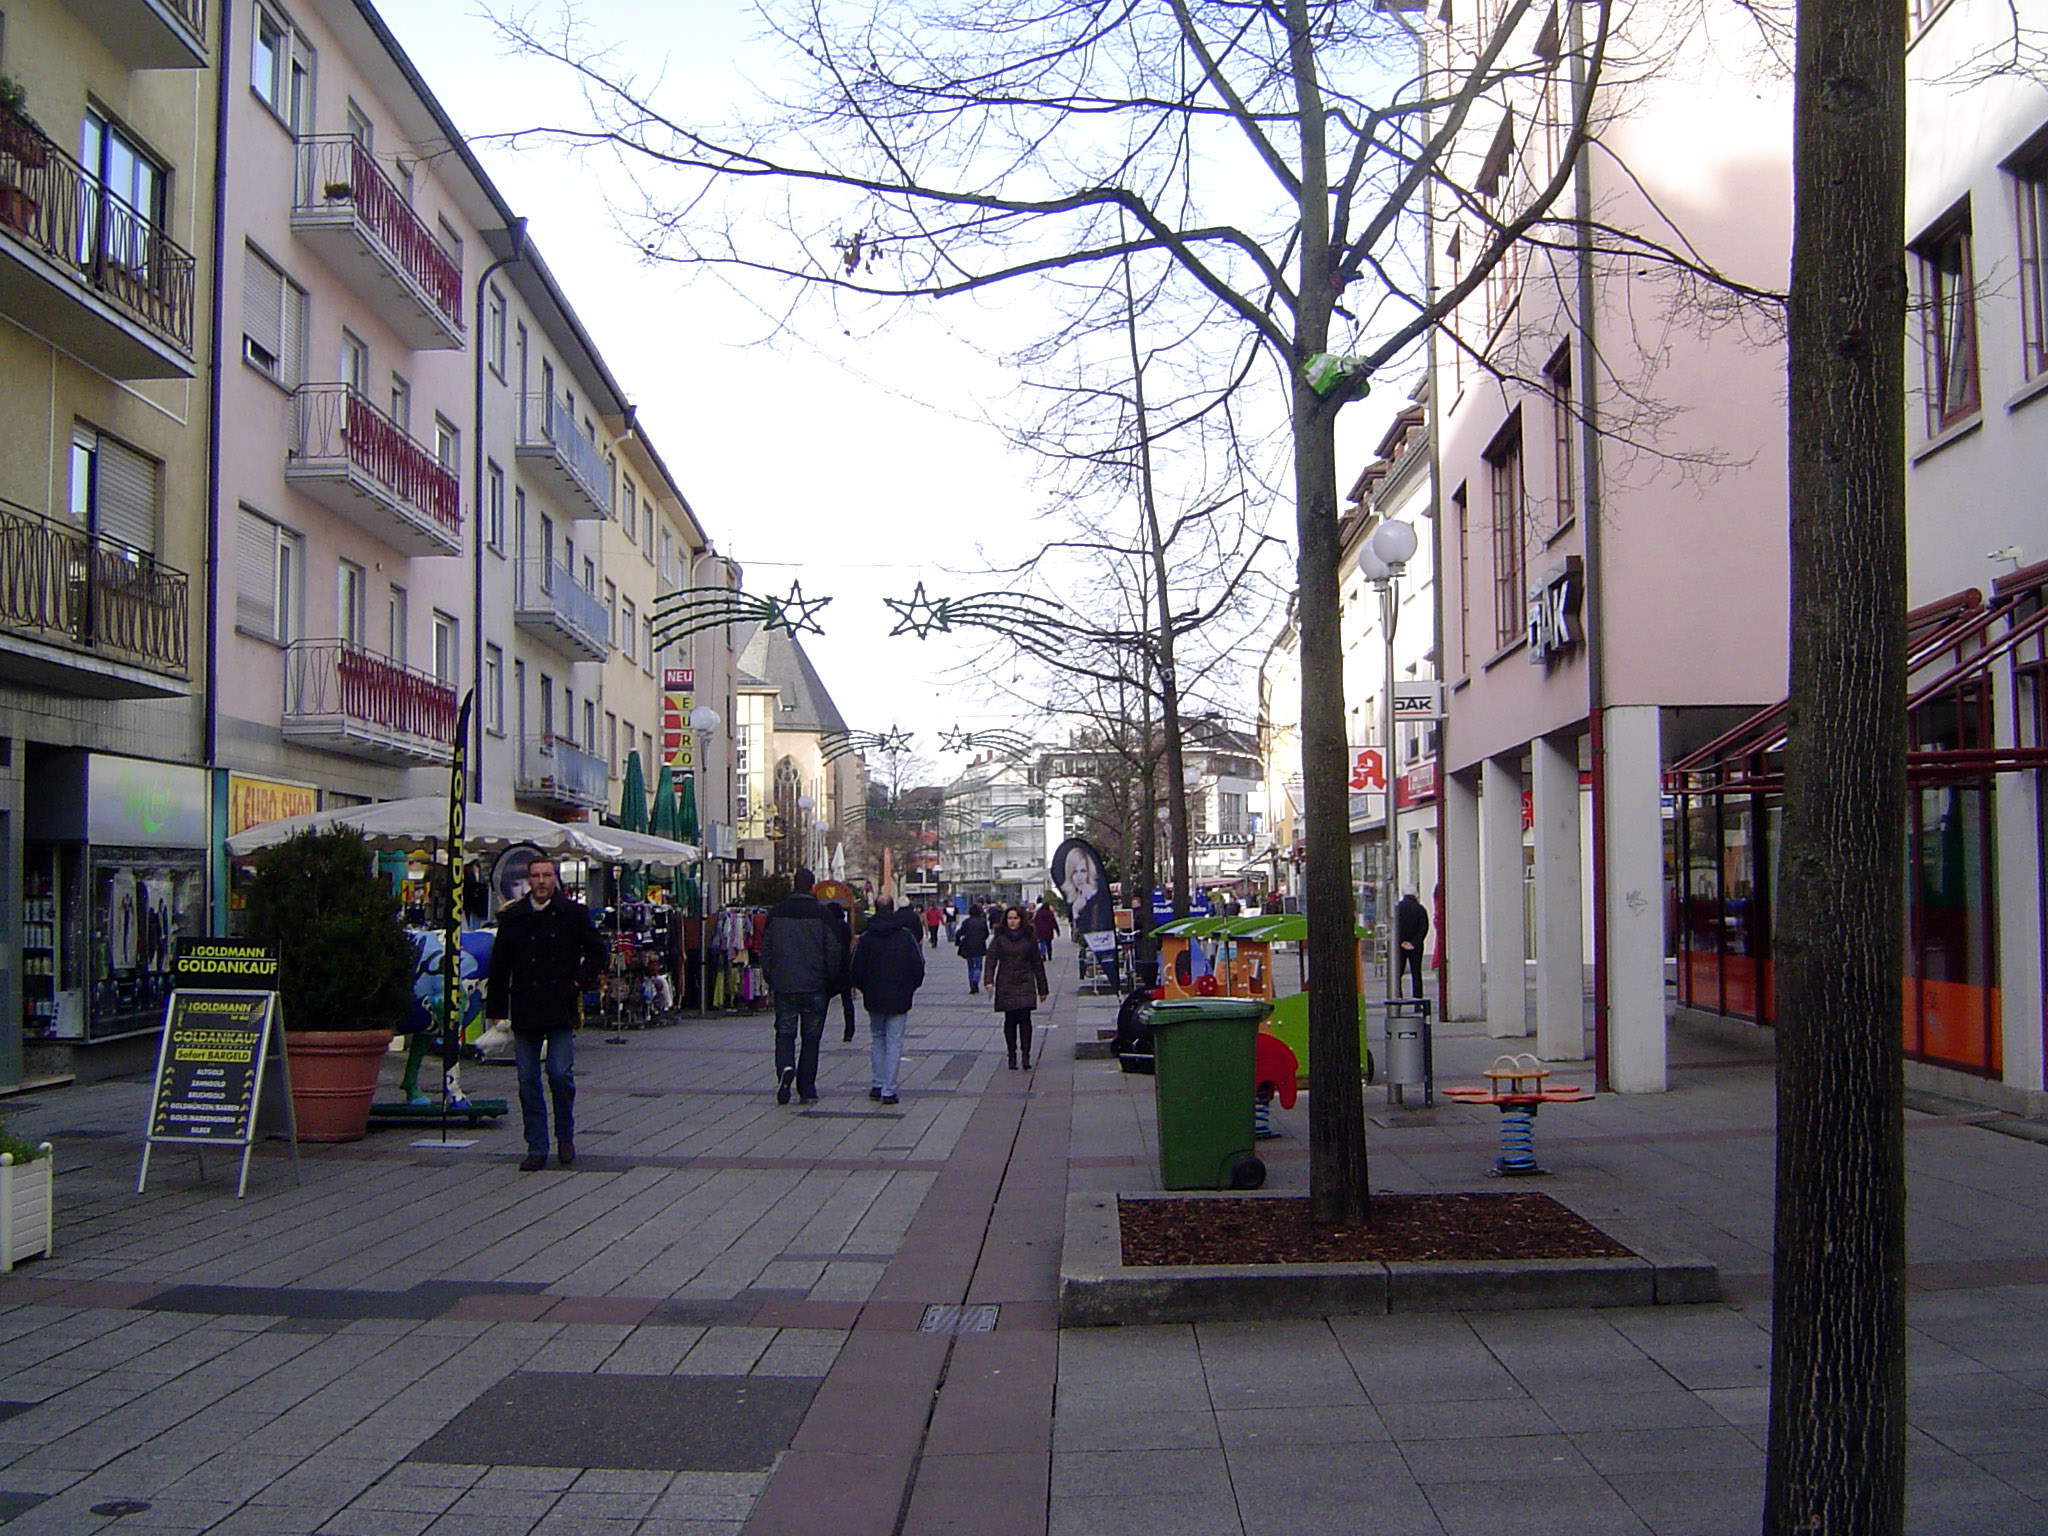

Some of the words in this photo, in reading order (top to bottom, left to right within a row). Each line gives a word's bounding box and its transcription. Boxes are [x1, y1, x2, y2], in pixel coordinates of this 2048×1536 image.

[667, 671, 693, 682] NEU
[1394, 697, 1432, 711] DAK
[682, 698, 692, 764] EURO
[178, 960, 277, 974] GOLDANKAUF
[173, 1031, 260, 1044] GOLDANKAUF
[177, 1050, 205, 1059] Sofort
[207, 1051, 249, 1060] BARGELD
